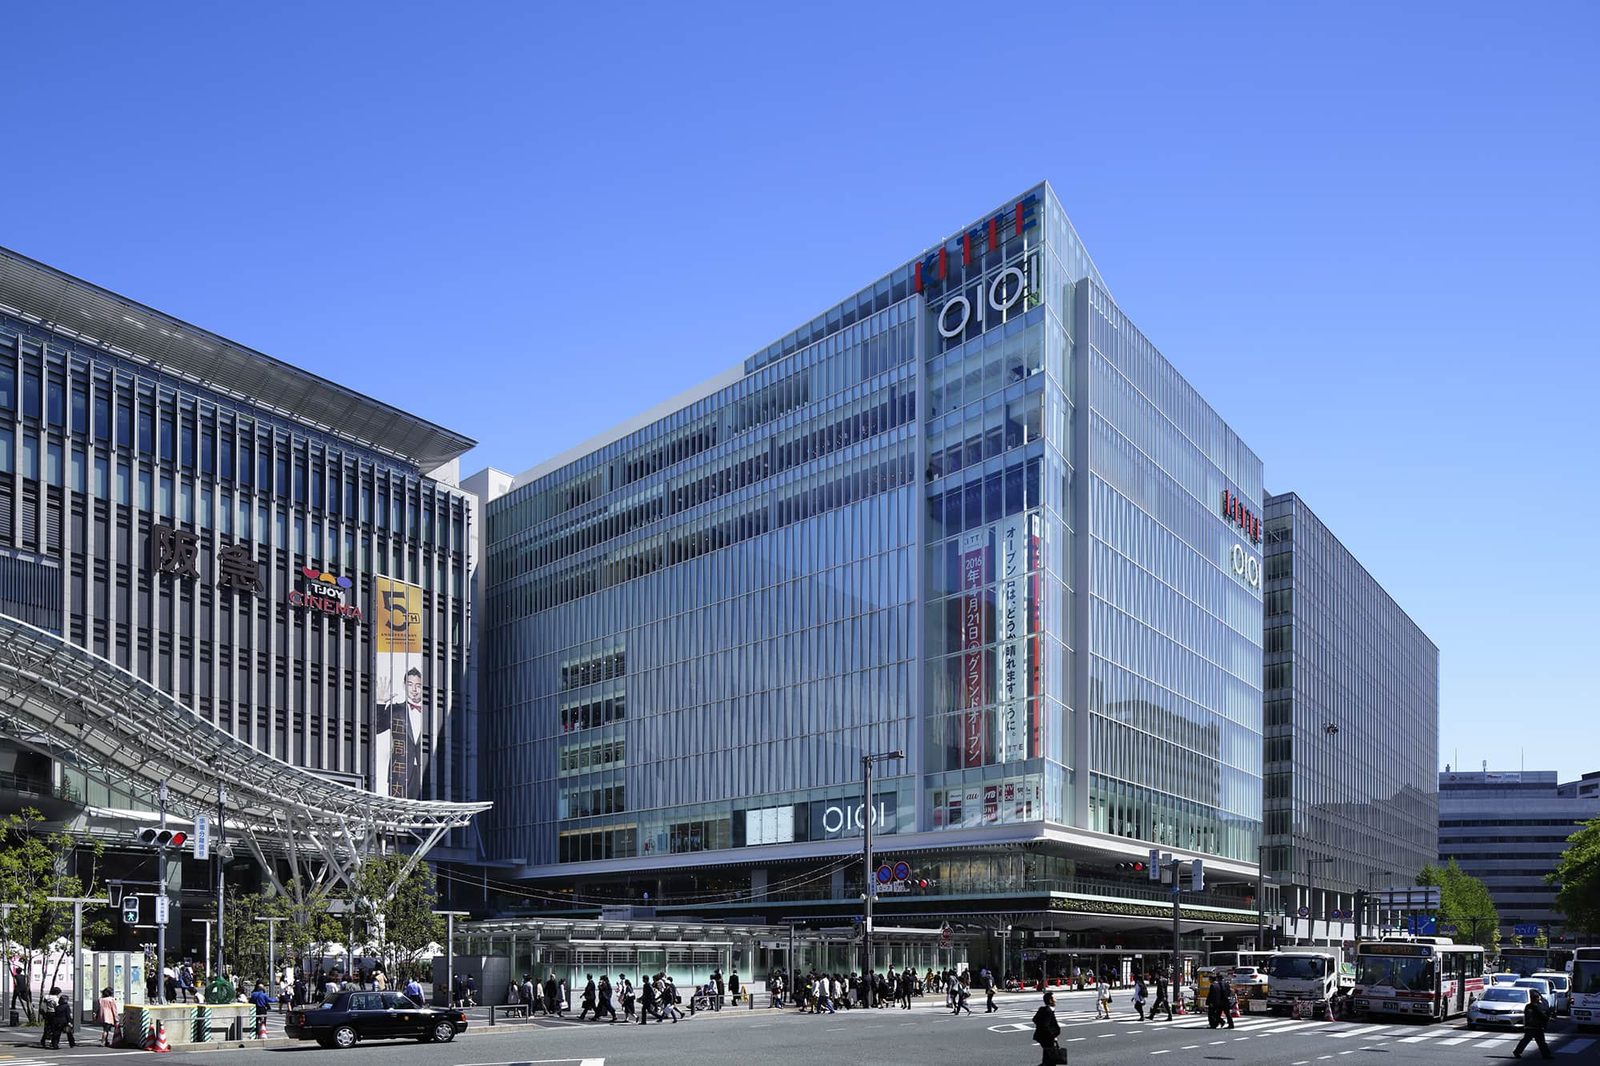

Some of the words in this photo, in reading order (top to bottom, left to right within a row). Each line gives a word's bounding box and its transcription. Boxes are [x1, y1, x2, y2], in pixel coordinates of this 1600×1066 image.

[914, 194, 1038, 293] KITTE
[152, 523, 264, 593] 阪急
[289, 590, 364, 620] CINEMA
[966, 792, 980, 801] au
